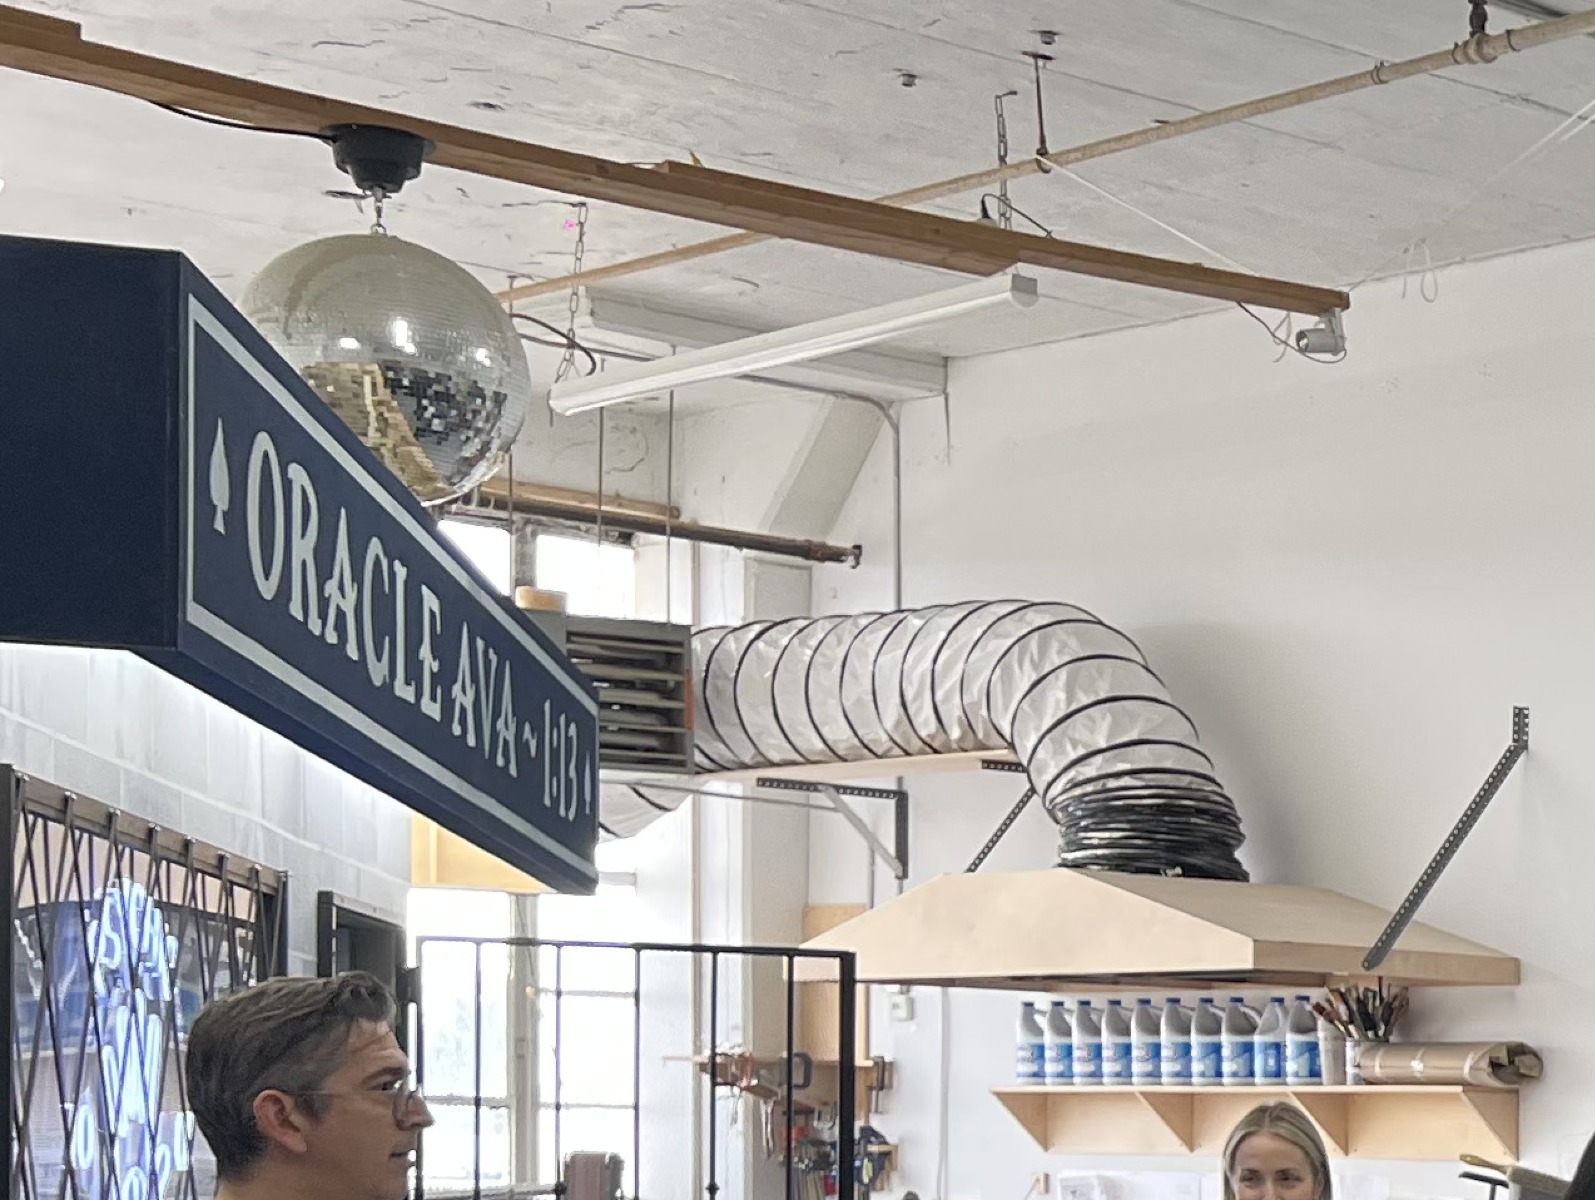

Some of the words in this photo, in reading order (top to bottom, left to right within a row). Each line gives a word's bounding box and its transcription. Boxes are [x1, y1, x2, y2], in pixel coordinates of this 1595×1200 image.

[246, 430, 442, 723] ORACLE
[451, 620, 518, 779] AVA
[543, 698, 577, 823] 1:13
